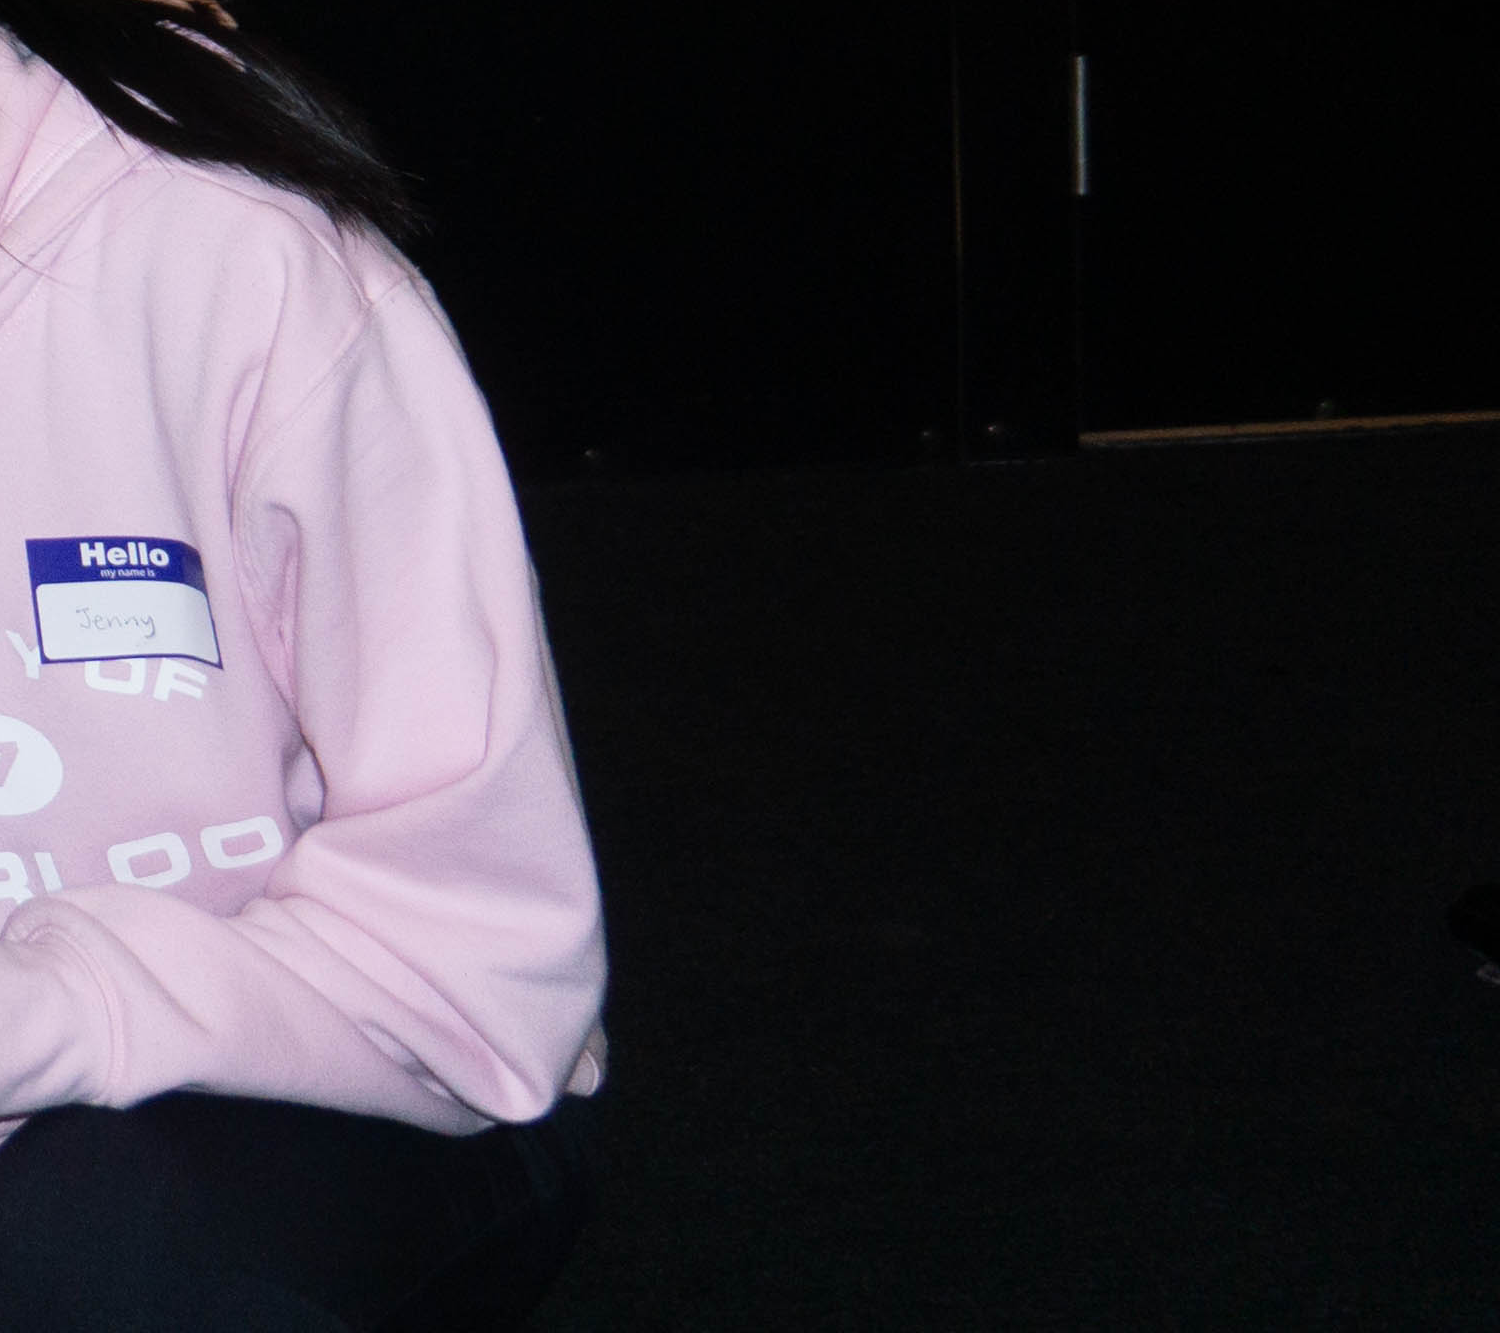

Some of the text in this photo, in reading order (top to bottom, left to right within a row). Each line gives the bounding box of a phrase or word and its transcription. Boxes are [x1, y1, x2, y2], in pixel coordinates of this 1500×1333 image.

[79, 541, 170, 567] Hello
[100, 567, 156, 579] my name is
[75, 606, 156, 639] Jenny
